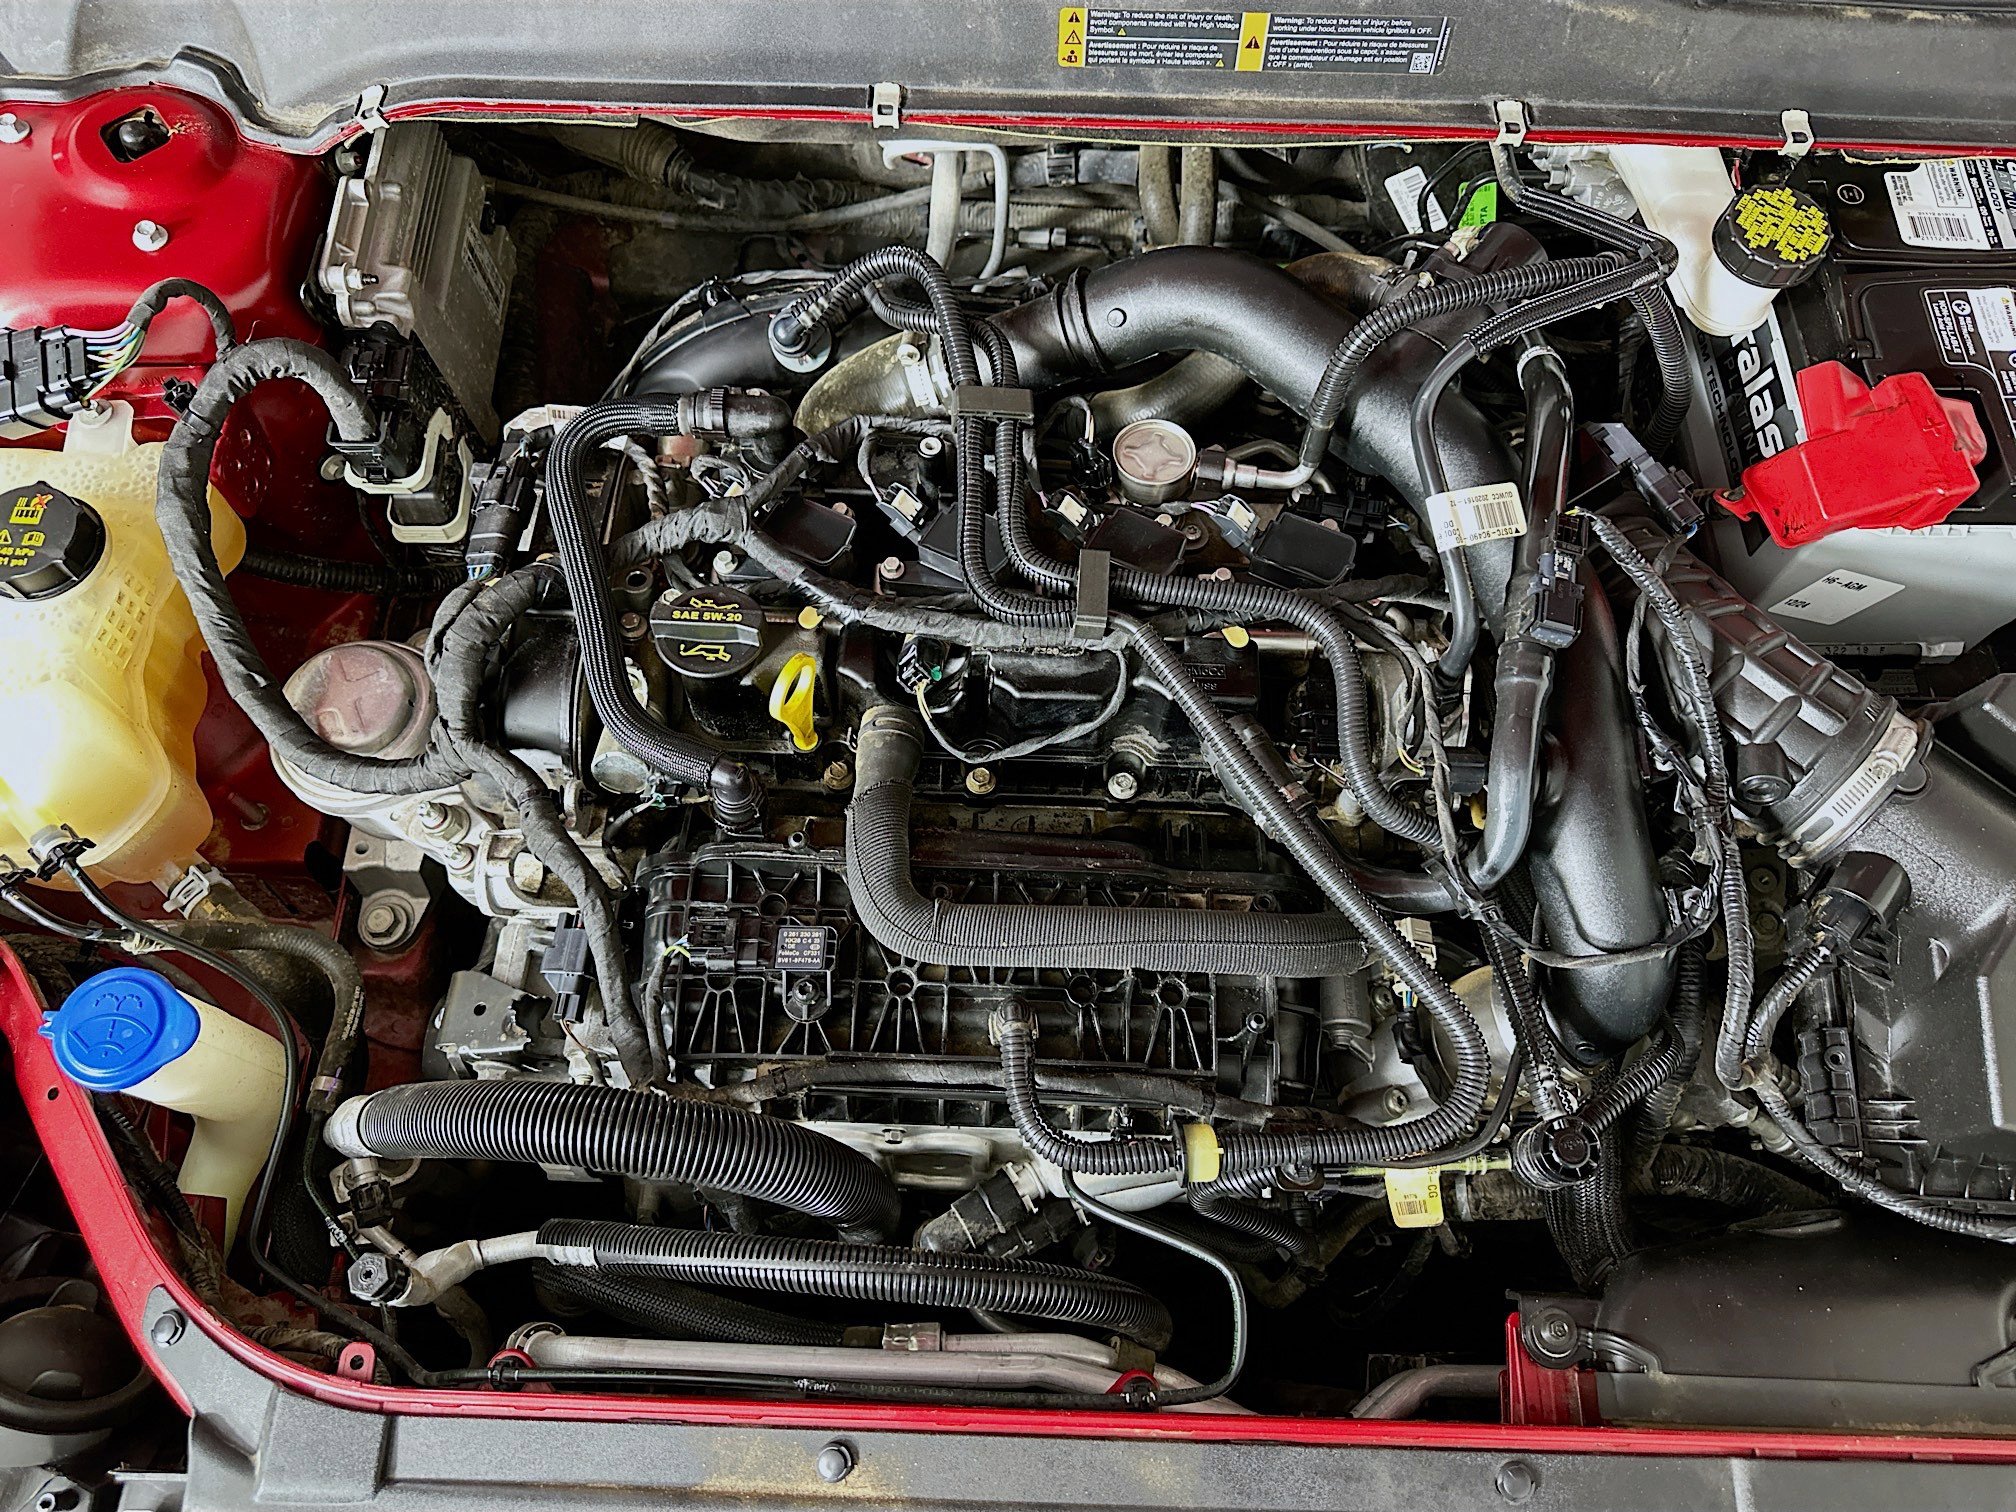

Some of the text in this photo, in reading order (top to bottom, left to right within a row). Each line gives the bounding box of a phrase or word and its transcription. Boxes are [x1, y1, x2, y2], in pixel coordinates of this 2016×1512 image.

[1980, 160, 2004, 214] CHNOLOGY
[1938, 300, 1962, 353] NON-SPILLABLE
[1724, 356, 1759, 465] PLATIN
[1731, 330, 1785, 458] ralas
[1822, 576, 1867, 592] H6-AGM
[672, 610, 743, 622] SAE 5W-20
